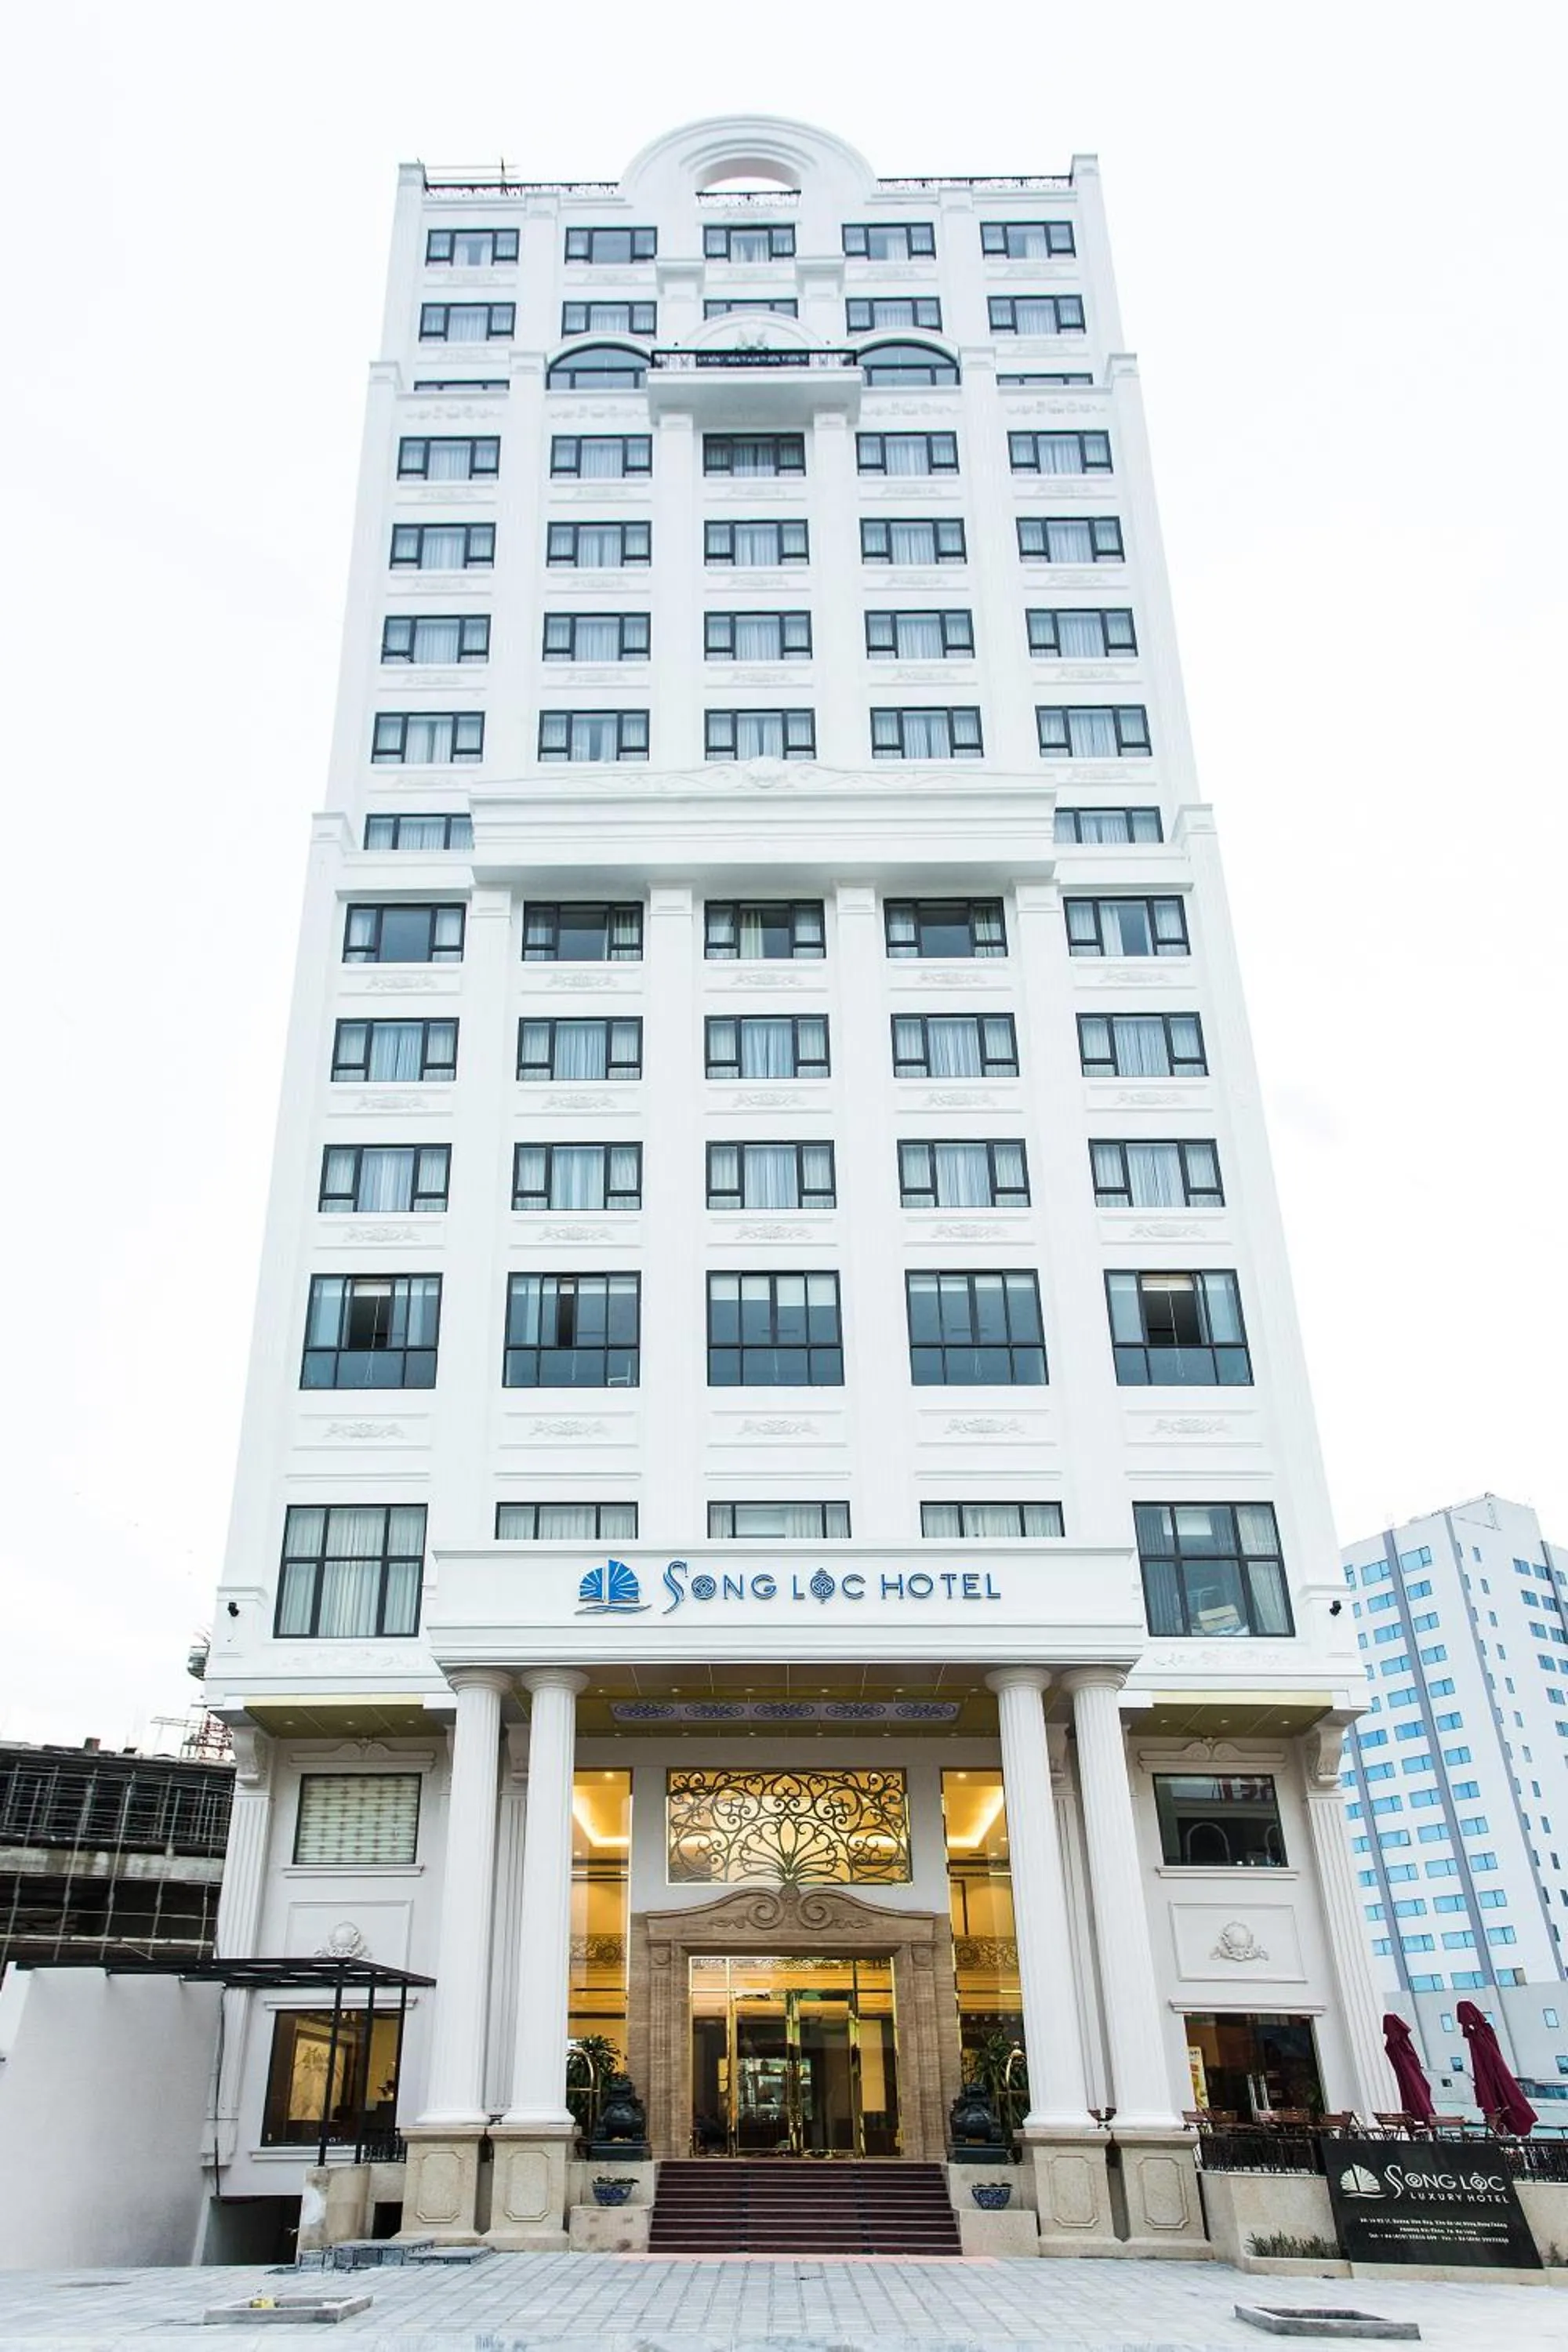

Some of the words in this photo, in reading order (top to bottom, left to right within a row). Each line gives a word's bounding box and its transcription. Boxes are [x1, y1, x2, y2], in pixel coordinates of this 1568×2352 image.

[662, 1560, 777, 1614] SONG
[881, 1573, 1001, 1600] HOTEL
[1384, 2165, 1456, 2198] SONG
[1410, 2192, 1462, 2202] LUXURY
[1468, 2194, 1510, 2204] HOTEL
